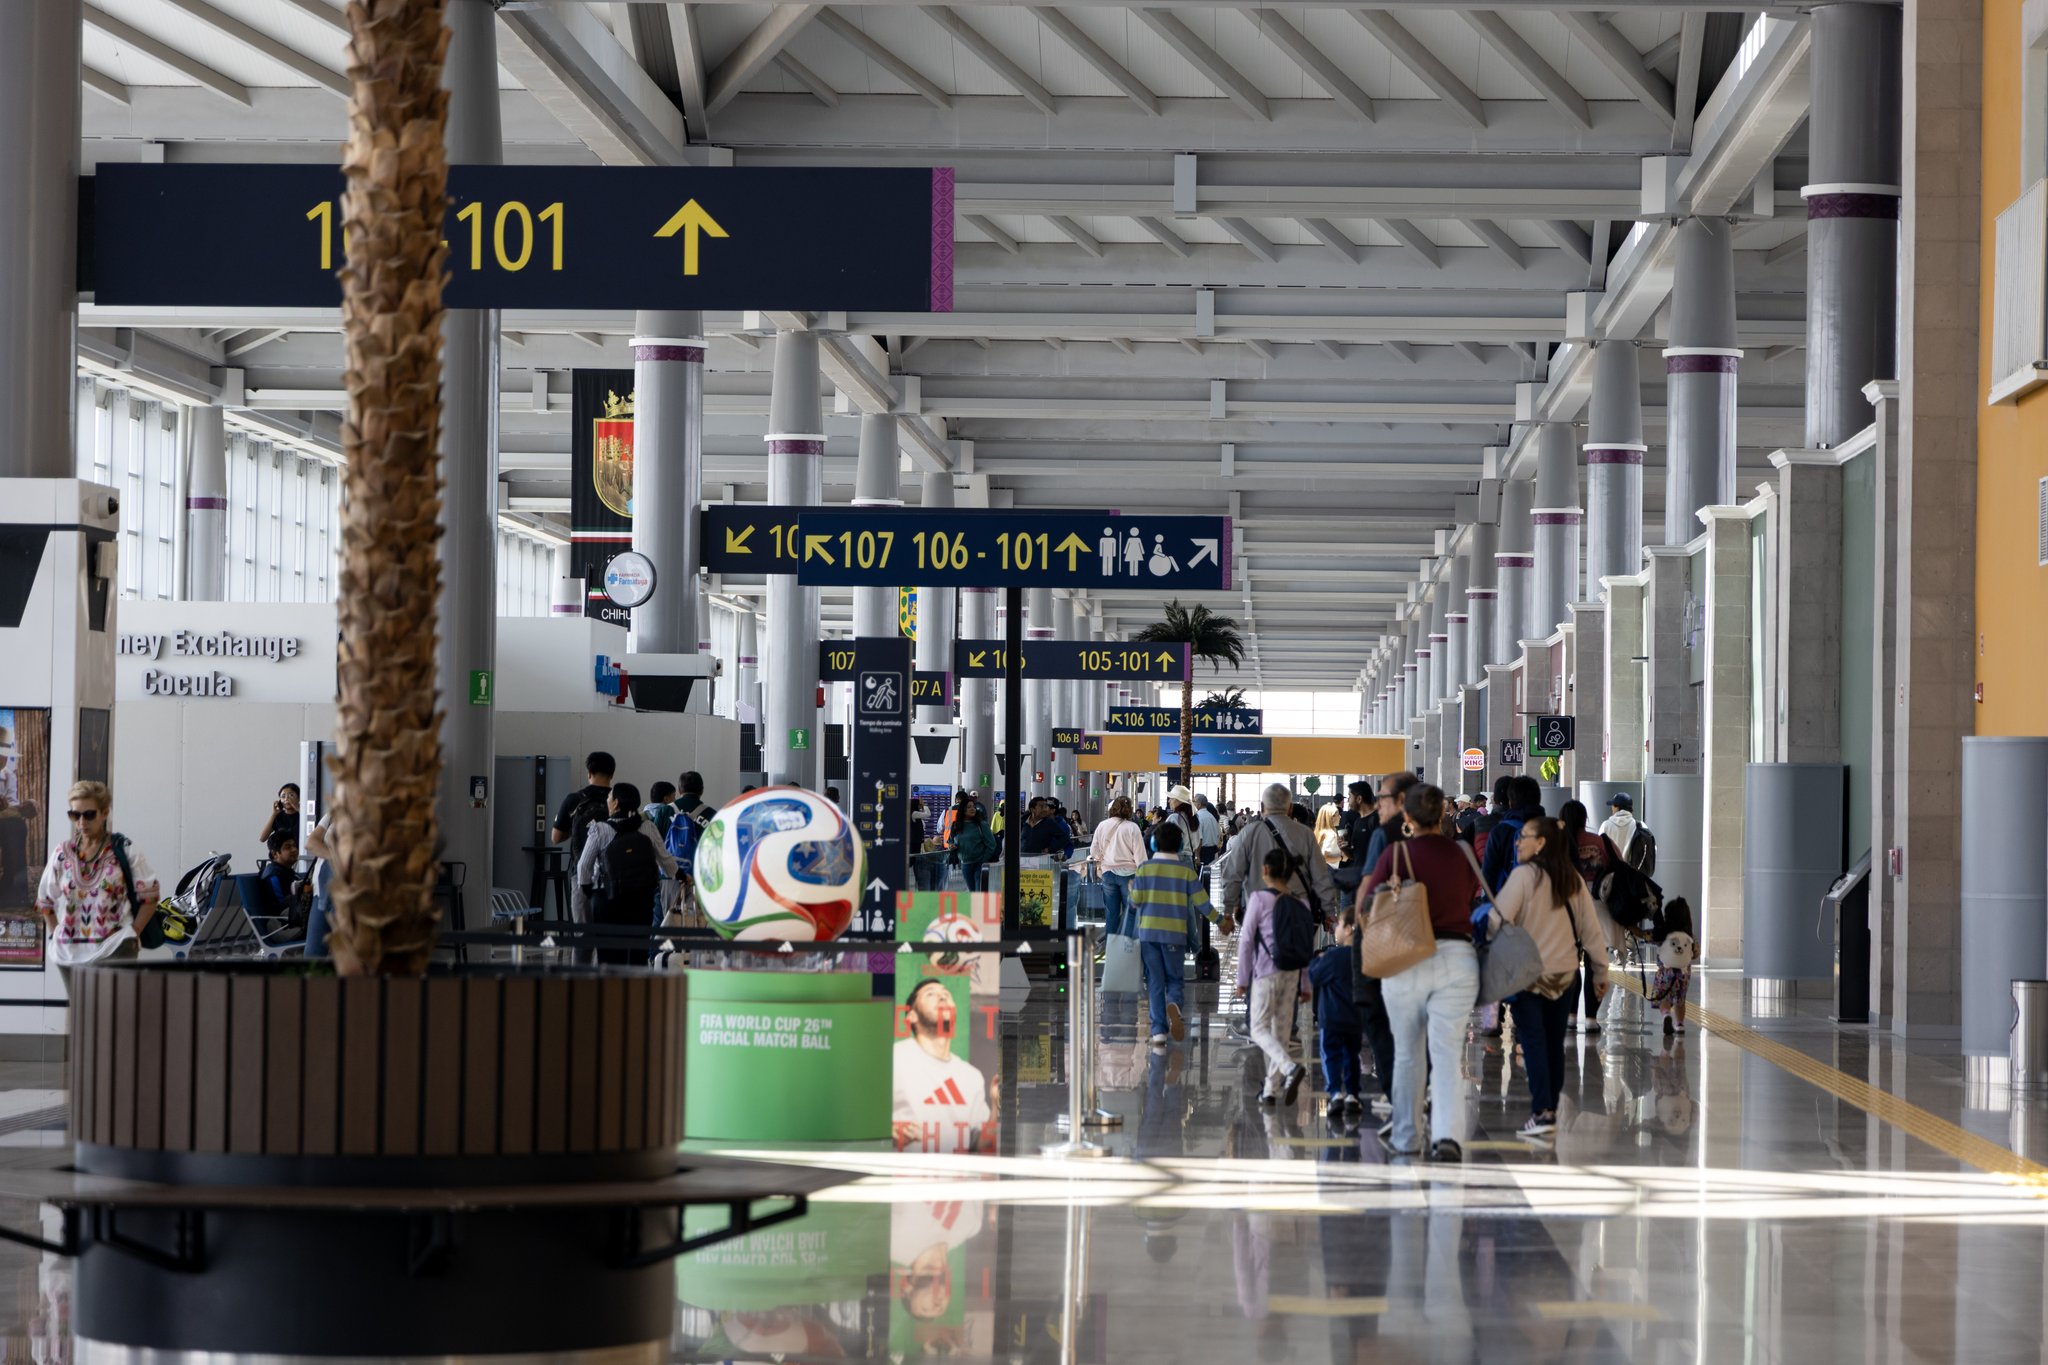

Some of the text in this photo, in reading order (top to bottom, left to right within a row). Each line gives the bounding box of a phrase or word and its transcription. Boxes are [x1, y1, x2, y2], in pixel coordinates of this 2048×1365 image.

[838, 531, 895, 570] 107
[912, 531, 969, 571] 106
[996, 532, 1049, 572] 101
[171, 629, 299, 663] Exchange
[828, 651, 856, 670] 107
[142, 668, 234, 697] Cocula
[931, 680, 942, 697] A
[1124, 712, 1145, 727] 106
[1150, 713, 1171, 728] 105
[1056, 732, 1080, 744] 106 B
[1091, 741, 1098, 751] A
[1672, 742, 1682, 756] P
[700, 1013, 723, 1030] FIFA
[725, 1014, 771, 1031] WORLD
[774, 1016, 801, 1031] CUP
[700, 1030, 831, 1050] OFFICIAL MATCH BALL
